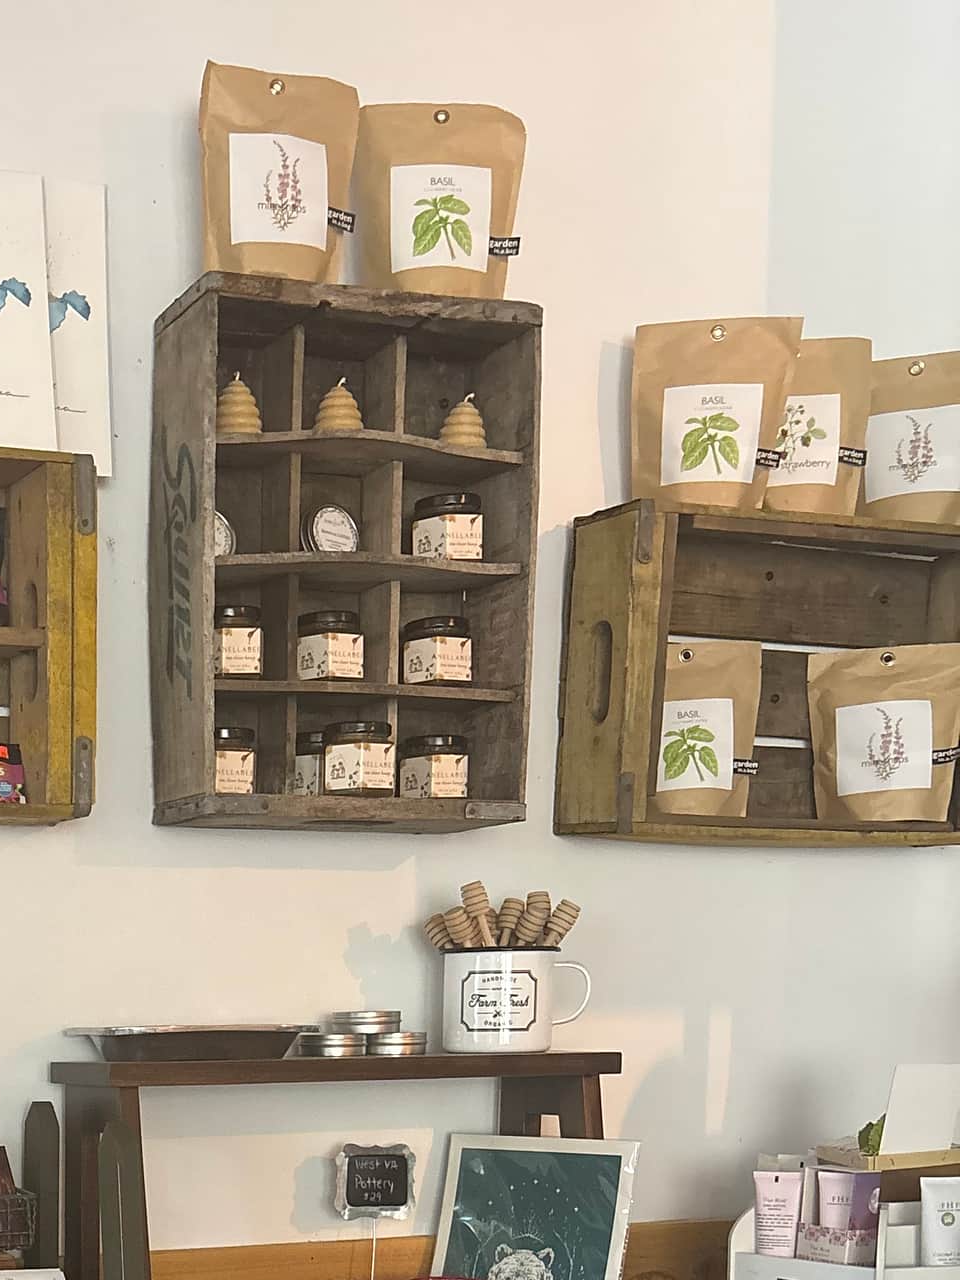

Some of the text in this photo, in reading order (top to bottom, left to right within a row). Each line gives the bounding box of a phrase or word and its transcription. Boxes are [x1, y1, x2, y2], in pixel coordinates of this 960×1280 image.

[430, 177, 455, 186] BASIL
[701, 396, 727, 405] BASIL
[780, 458, 831, 473] strawberry
[677, 711, 701, 719] BASIL
[482, 975, 517, 983] HANDE
[468, 993, 497, 1008] Farm
[355, 1159, 380, 1170] West
[354, 1174, 394, 1194] Pottery
